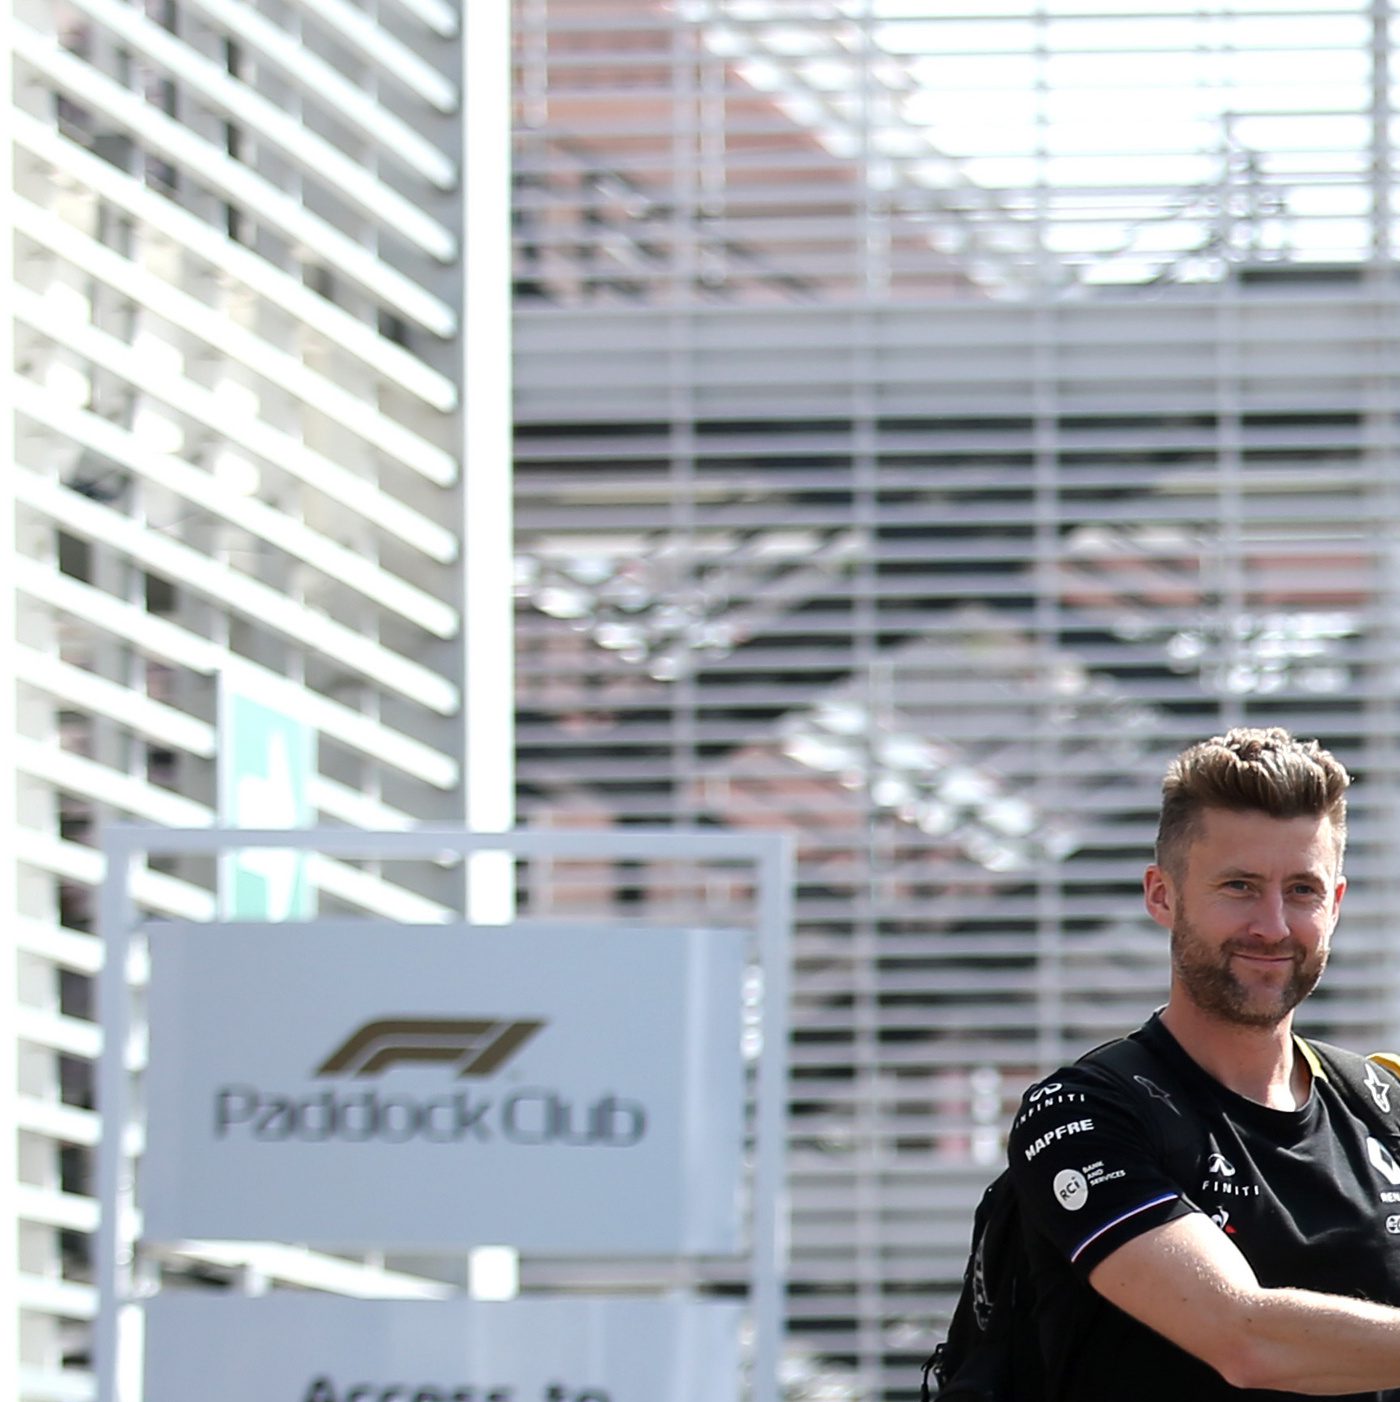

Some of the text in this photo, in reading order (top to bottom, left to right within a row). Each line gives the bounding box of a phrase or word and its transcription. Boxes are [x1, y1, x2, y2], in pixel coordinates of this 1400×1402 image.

[212, 1084, 646, 1148] Paddock Club
[1024, 1118, 1095, 1161] MAPFRE
